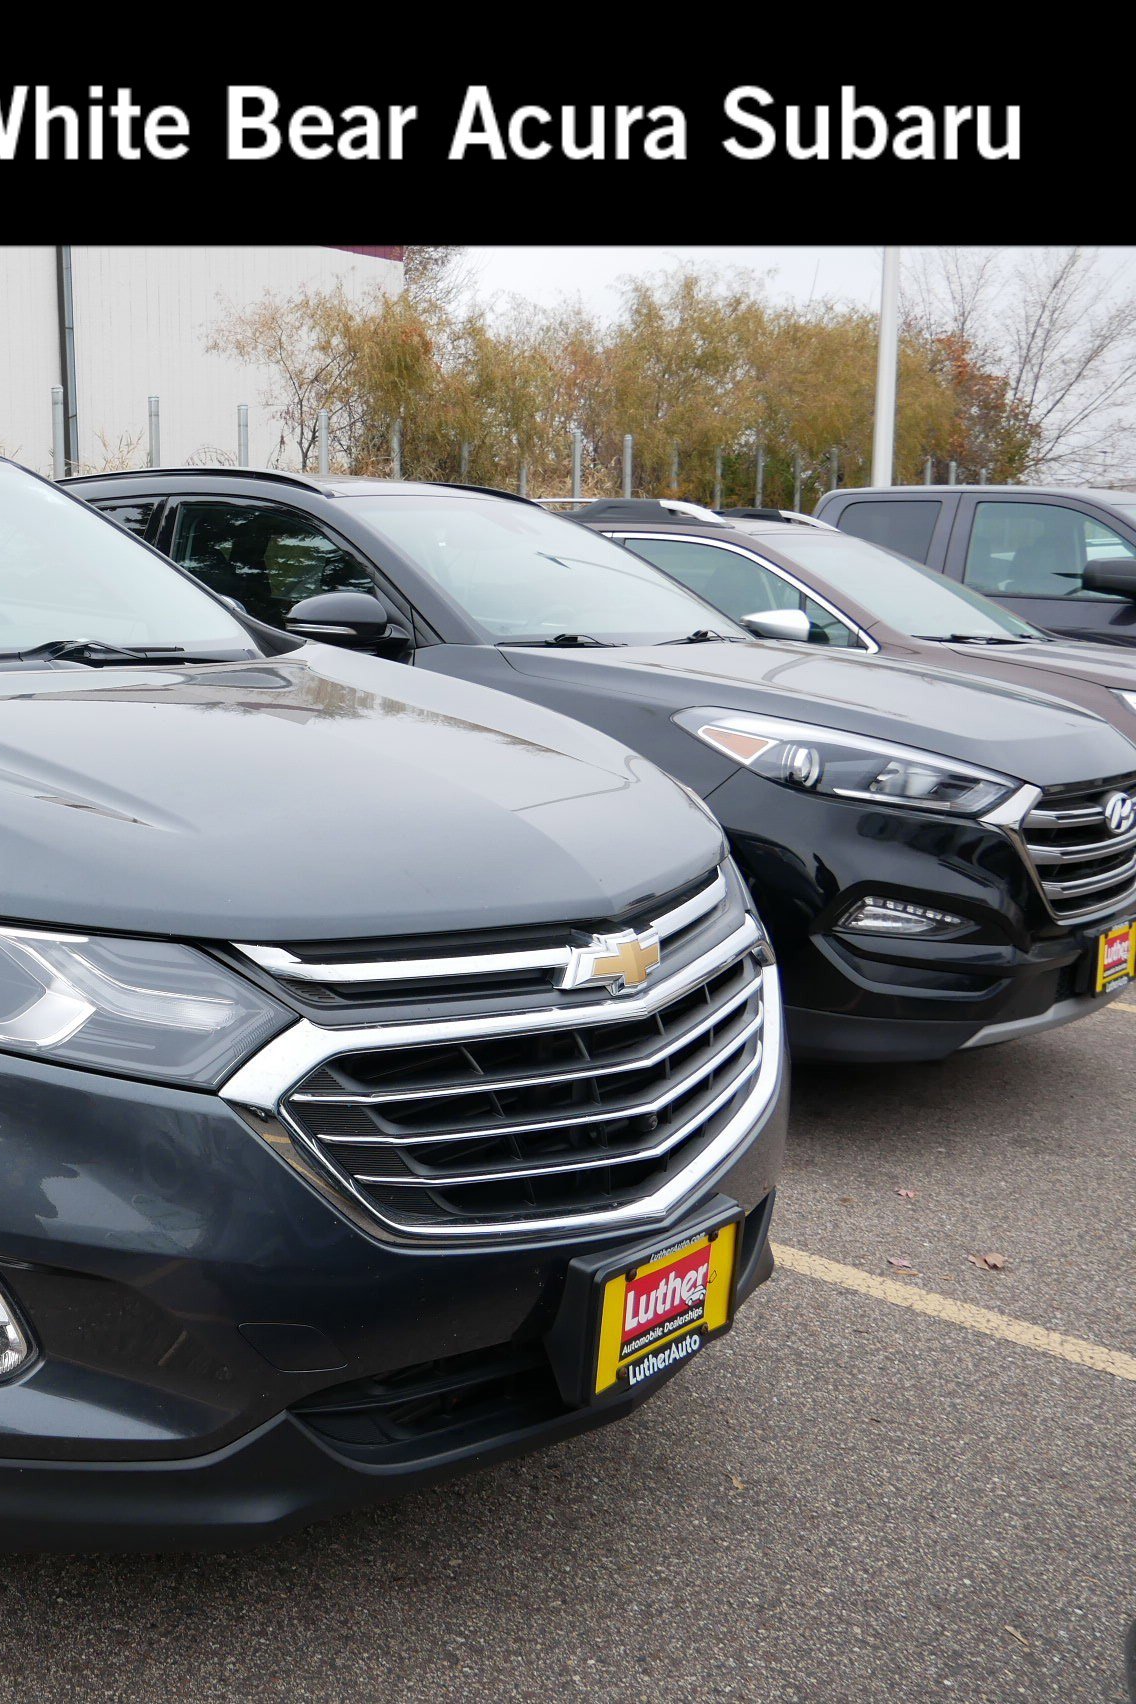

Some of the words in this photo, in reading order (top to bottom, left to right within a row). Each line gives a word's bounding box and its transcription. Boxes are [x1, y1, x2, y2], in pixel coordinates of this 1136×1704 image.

[624, 1262, 709, 1332] Luther
[621, 1326, 663, 1356] Automobile
[663, 1306, 703, 1333] Dealerships
[628, 1334, 700, 1386] LutherAuto
